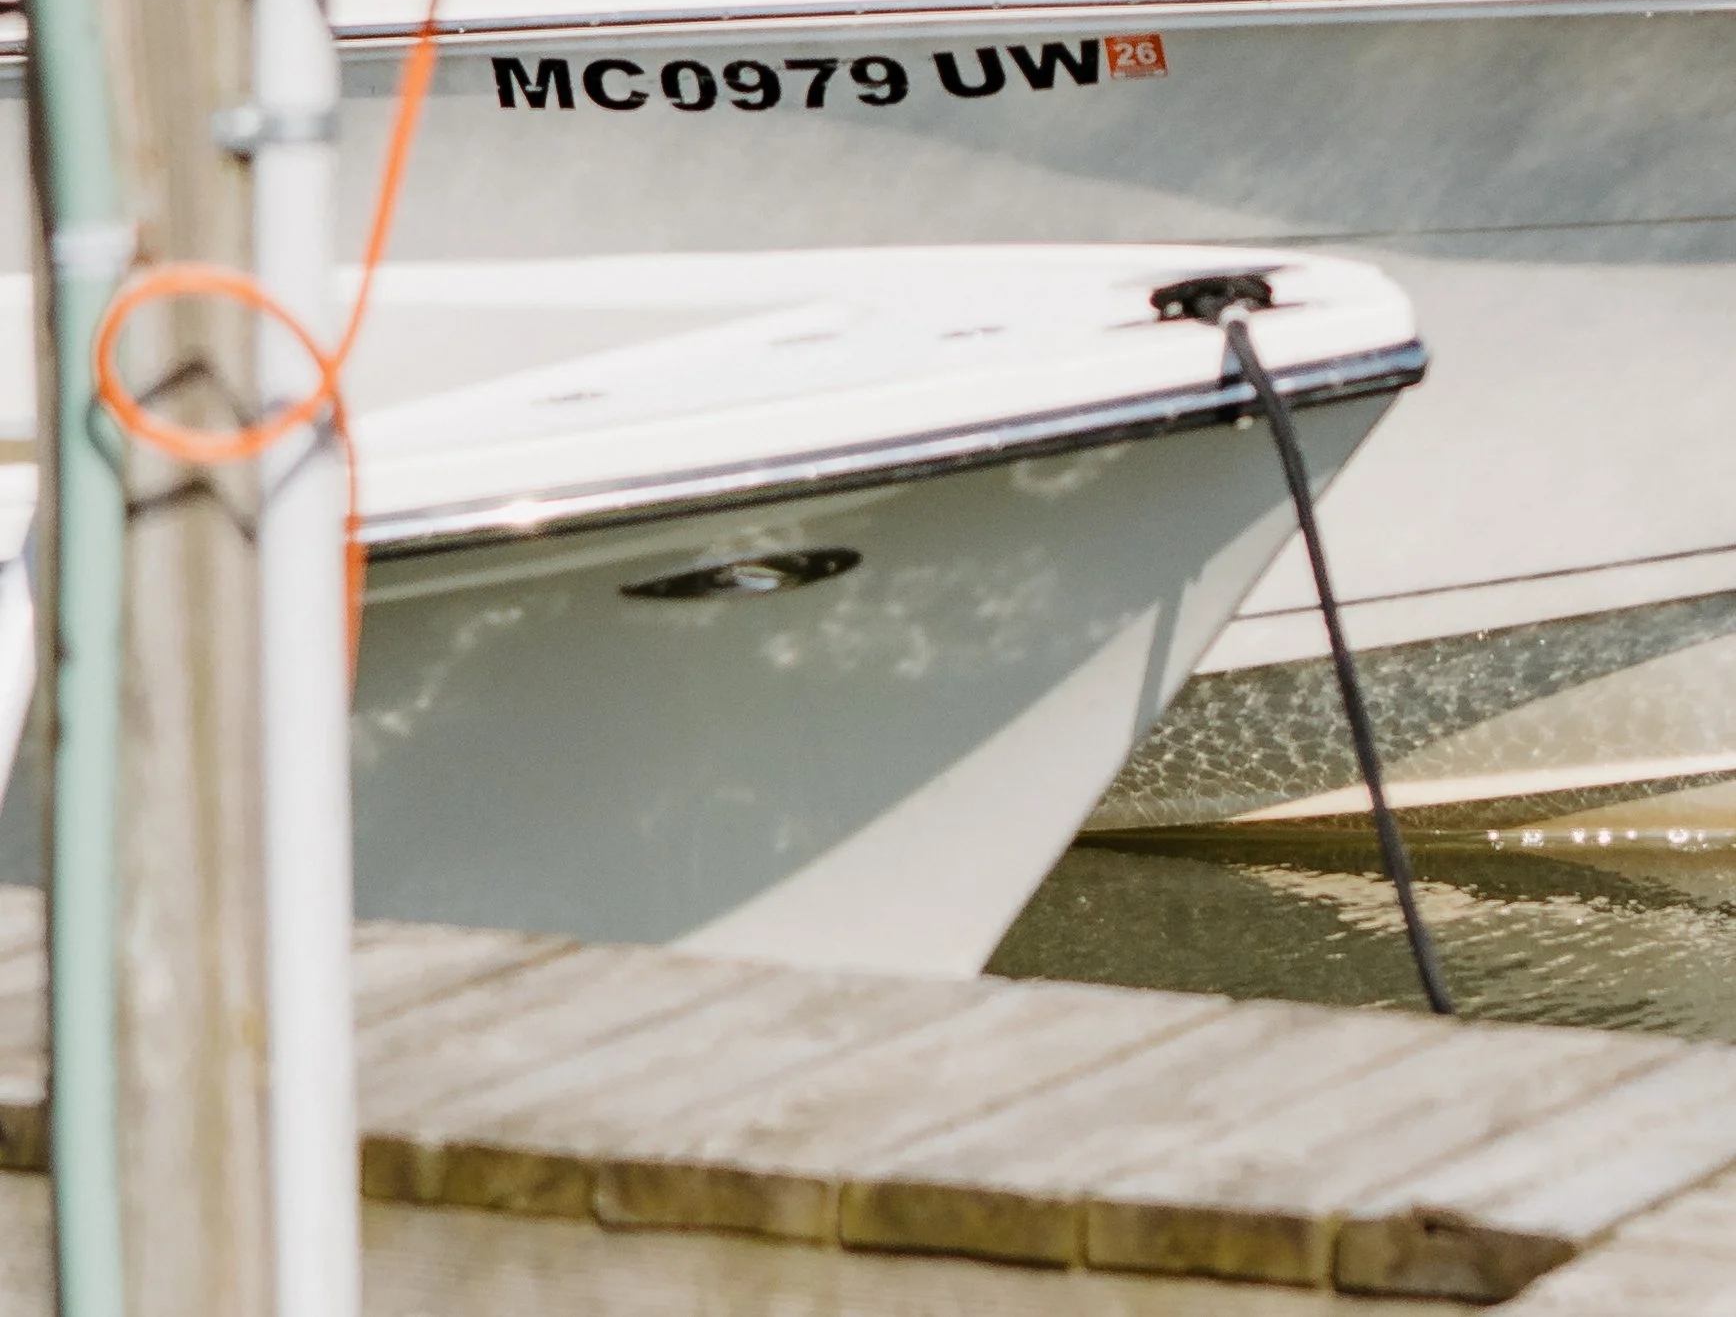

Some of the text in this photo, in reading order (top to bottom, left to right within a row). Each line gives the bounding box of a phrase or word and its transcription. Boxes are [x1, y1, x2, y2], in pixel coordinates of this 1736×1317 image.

[491, 38, 1100, 111] MC0979 UW
[1112, 41, 1158, 67] 26
